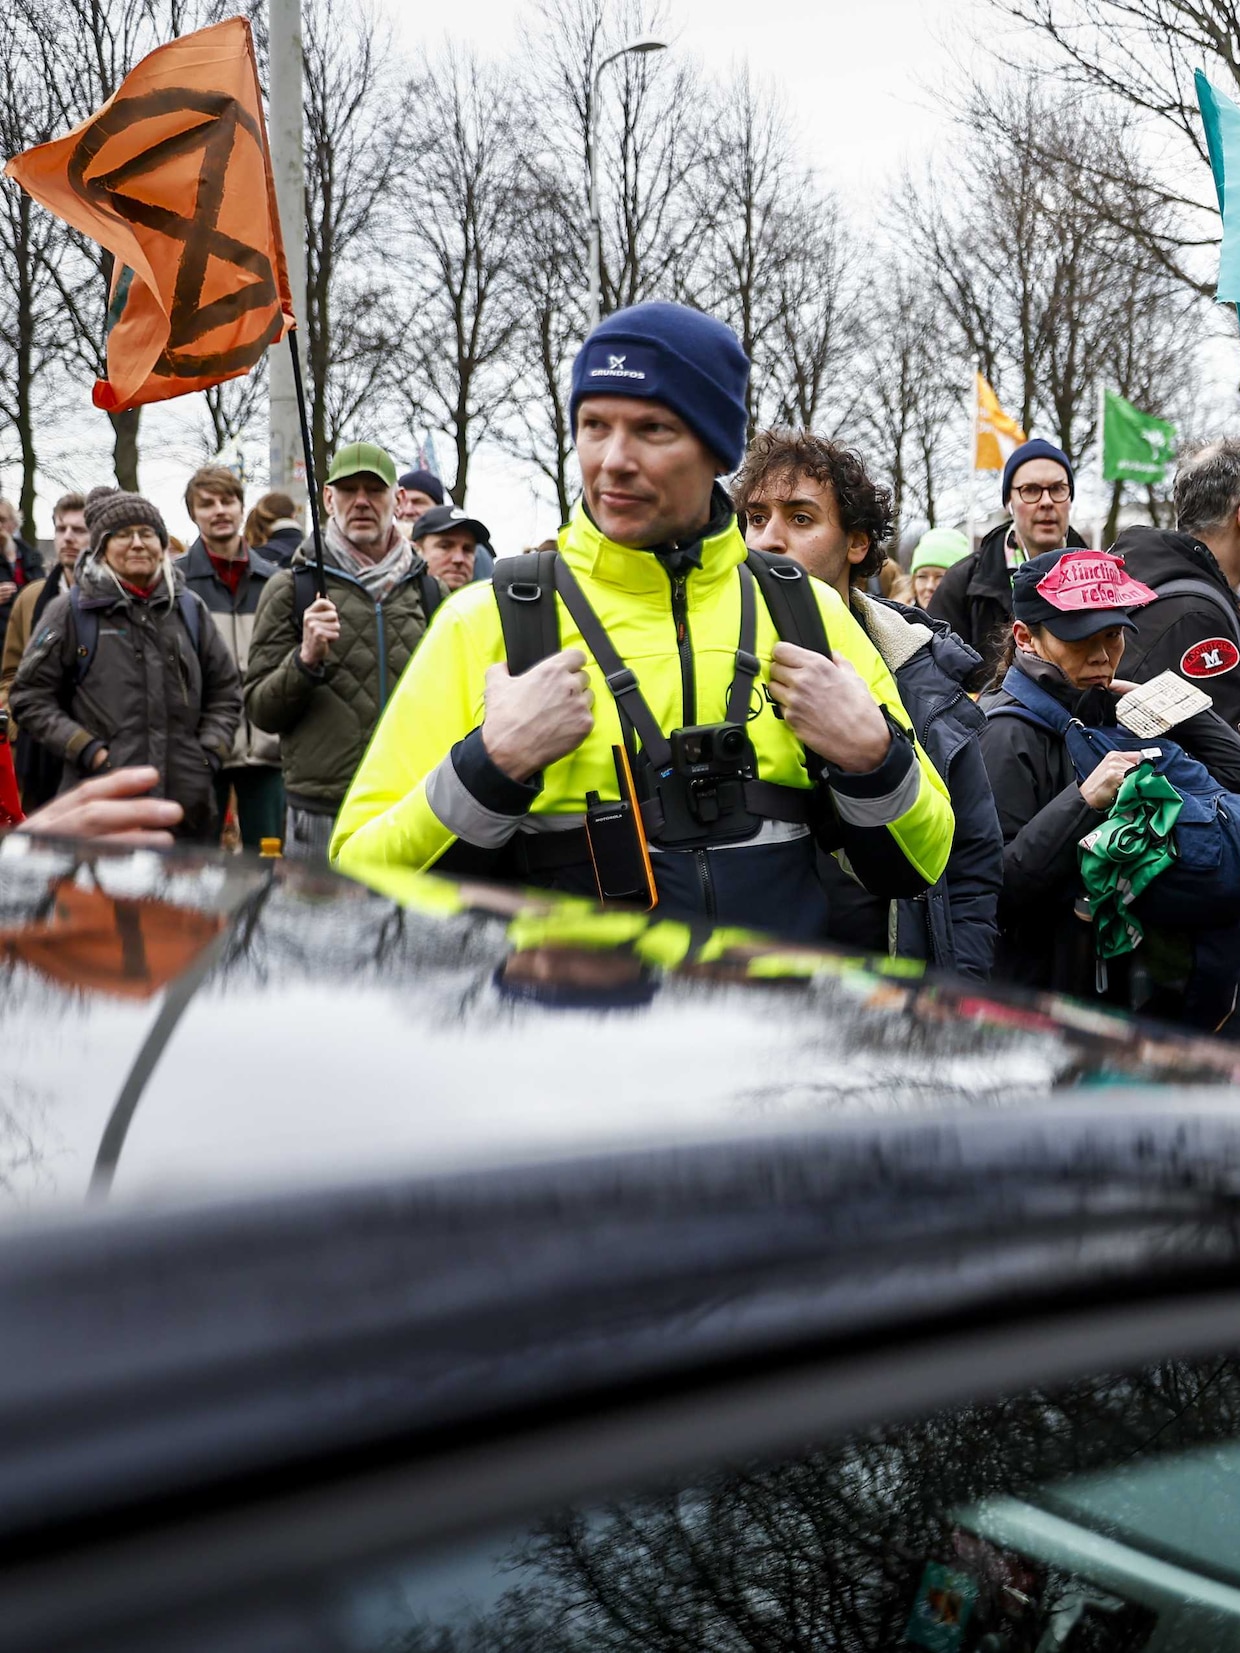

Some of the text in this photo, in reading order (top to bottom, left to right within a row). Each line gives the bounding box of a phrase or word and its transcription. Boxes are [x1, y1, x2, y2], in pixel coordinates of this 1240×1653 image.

[591, 370, 645, 380] GRUNDFOS
[1058, 562, 1120, 584] xtinction
[1201, 648, 1223, 669] M
[595, 814, 622, 823] MOTOROLA
